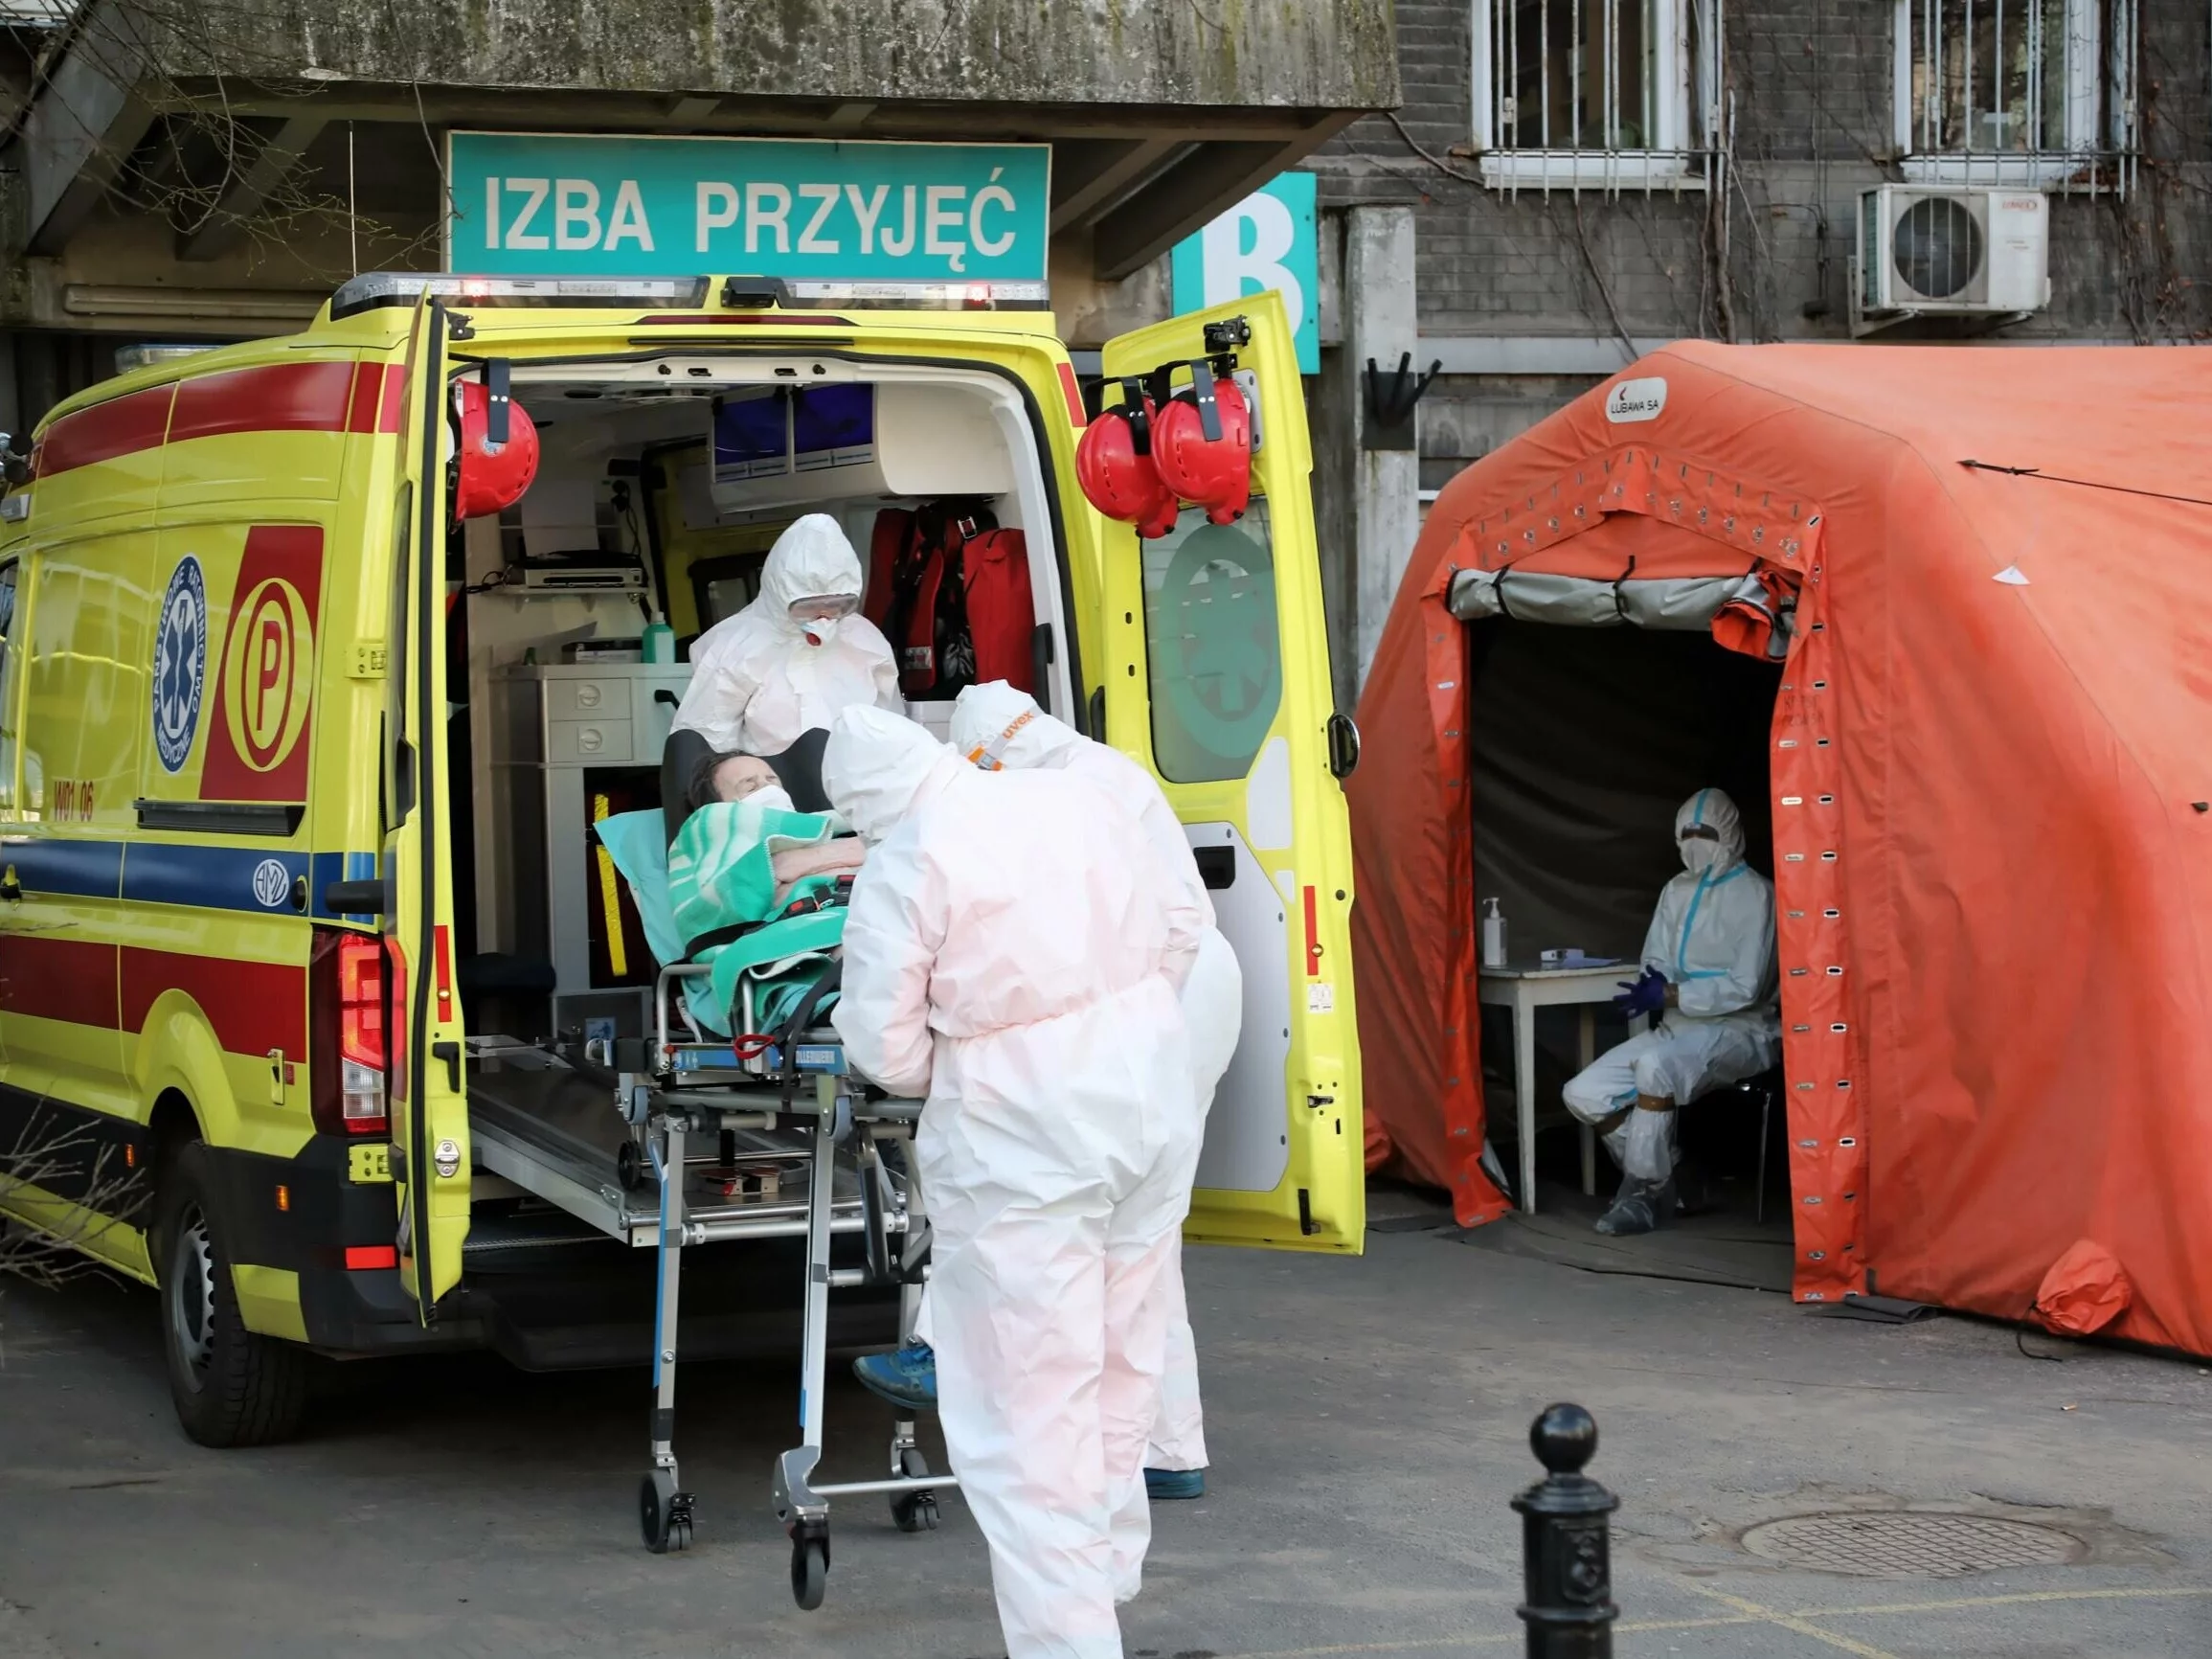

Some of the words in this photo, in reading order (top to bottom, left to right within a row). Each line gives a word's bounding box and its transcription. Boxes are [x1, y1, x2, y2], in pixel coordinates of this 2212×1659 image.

[485, 177, 655, 251] IZBA
[696, 167, 1017, 272] PRZYJĘĆ
[1202, 192, 1303, 338] B
[1611, 400, 1644, 414] LUBAWA
[1647, 399, 1659, 411] SA
[257, 620, 282, 731] P
[157, 722, 191, 763] MEDYCZNE
[1002, 711, 1034, 739] uvex
[80, 781, 94, 823] 06
